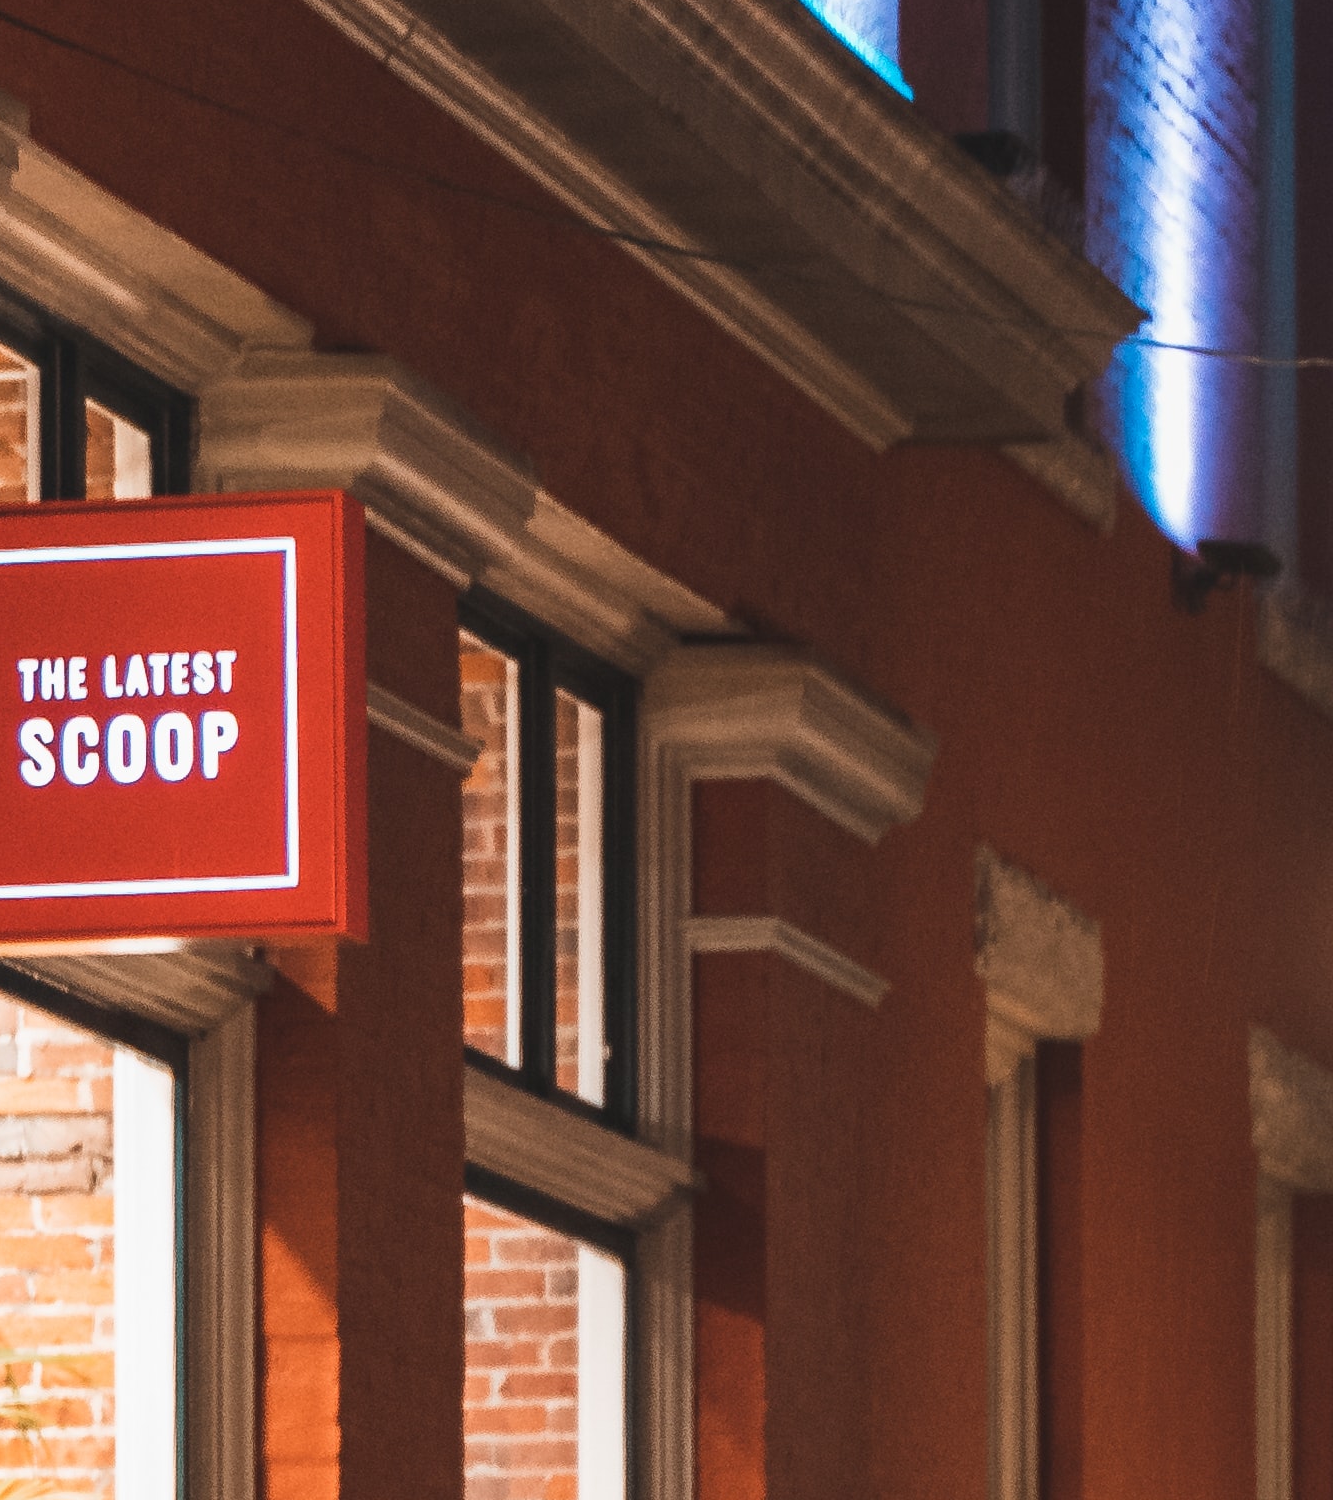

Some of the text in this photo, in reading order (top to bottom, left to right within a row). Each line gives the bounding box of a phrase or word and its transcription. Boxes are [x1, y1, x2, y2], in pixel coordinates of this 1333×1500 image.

[17, 650, 238, 702] THE LATEST
[18, 710, 240, 788] SCOOP
